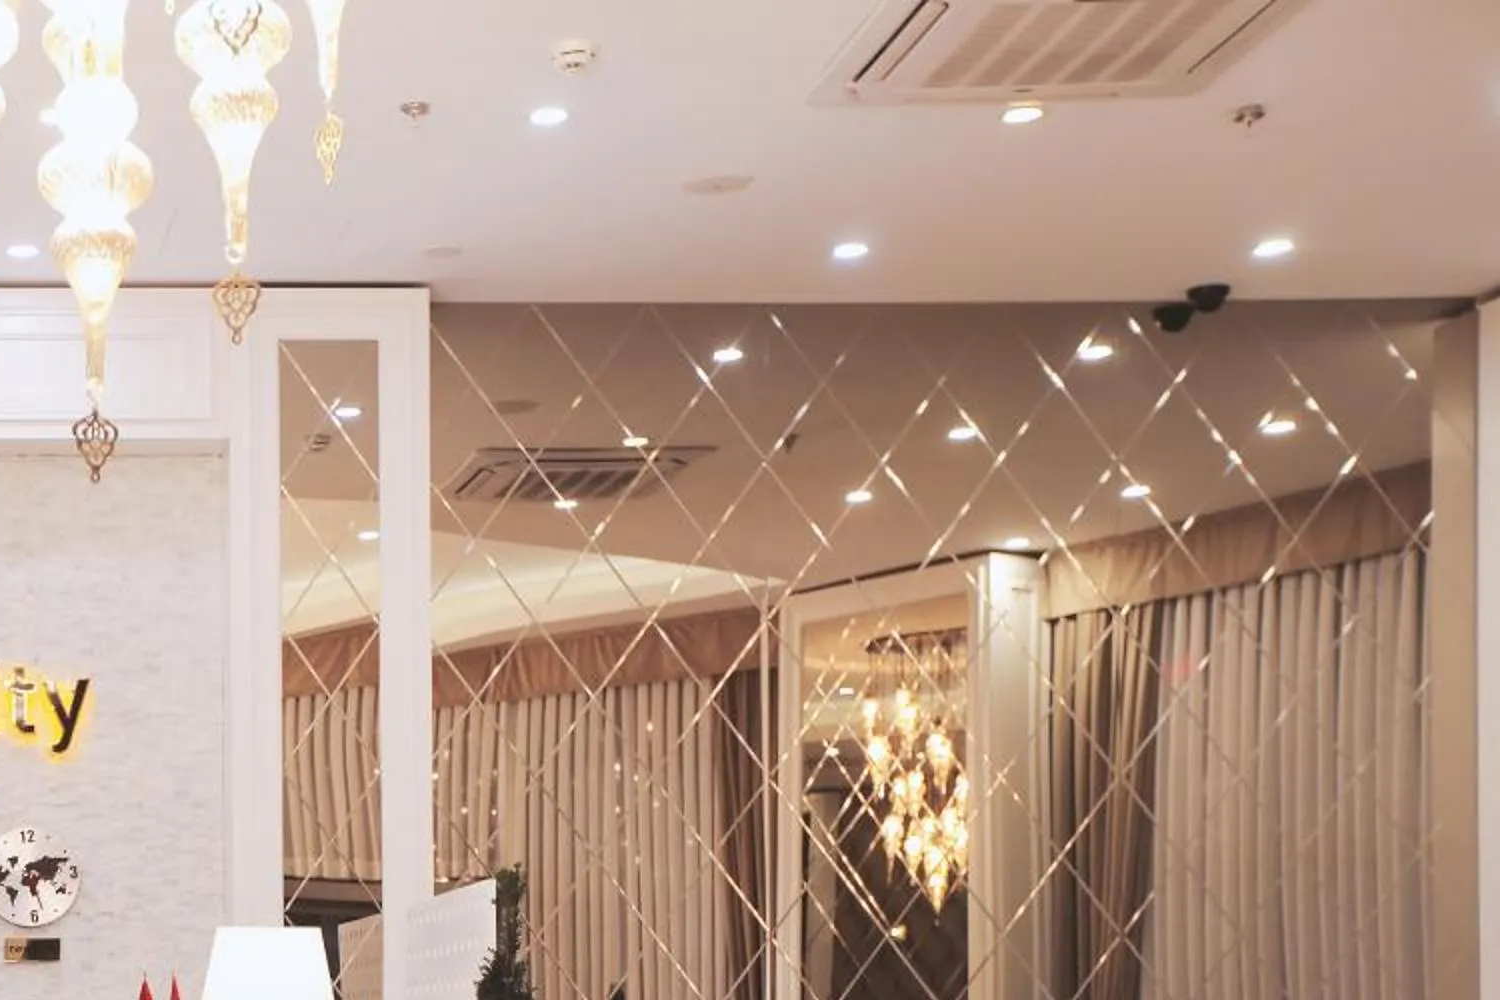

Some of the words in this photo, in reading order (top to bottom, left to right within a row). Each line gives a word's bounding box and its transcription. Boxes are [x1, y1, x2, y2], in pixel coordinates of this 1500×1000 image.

[19, 829, 35, 843] 12
[69, 866, 78, 878] 3
[30, 909, 39, 923] 6
